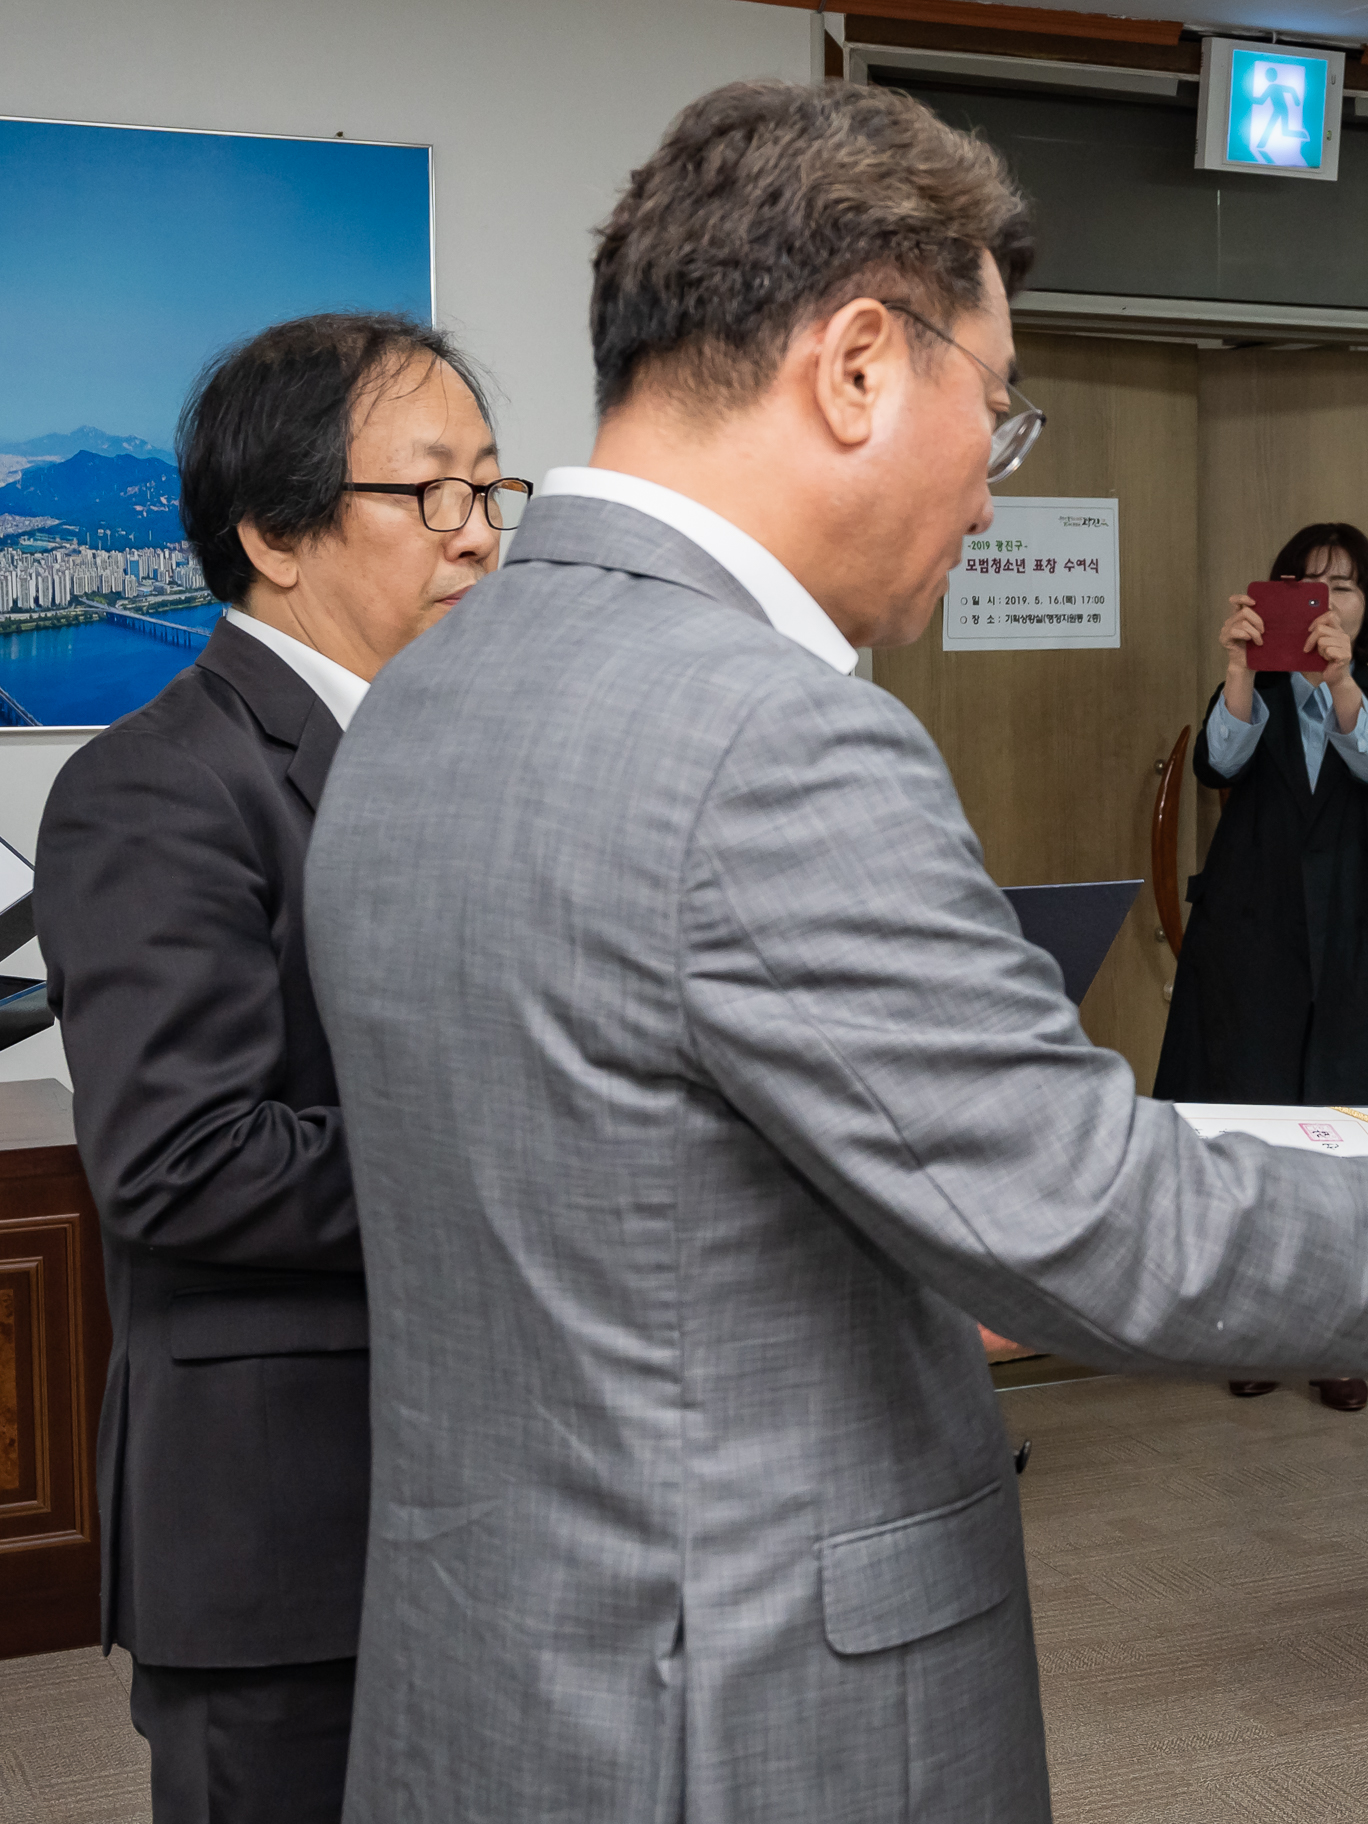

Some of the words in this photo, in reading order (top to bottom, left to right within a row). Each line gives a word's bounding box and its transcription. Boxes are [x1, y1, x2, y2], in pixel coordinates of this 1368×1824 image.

[965, 558, 1026, 574] 모범청소년
[1032, 558, 1057, 574] 표창
[1064, 558, 1099, 574] 수여식
[1005, 596, 1030, 605] 2019.
[1081, 596, 1105, 605] 17:00
